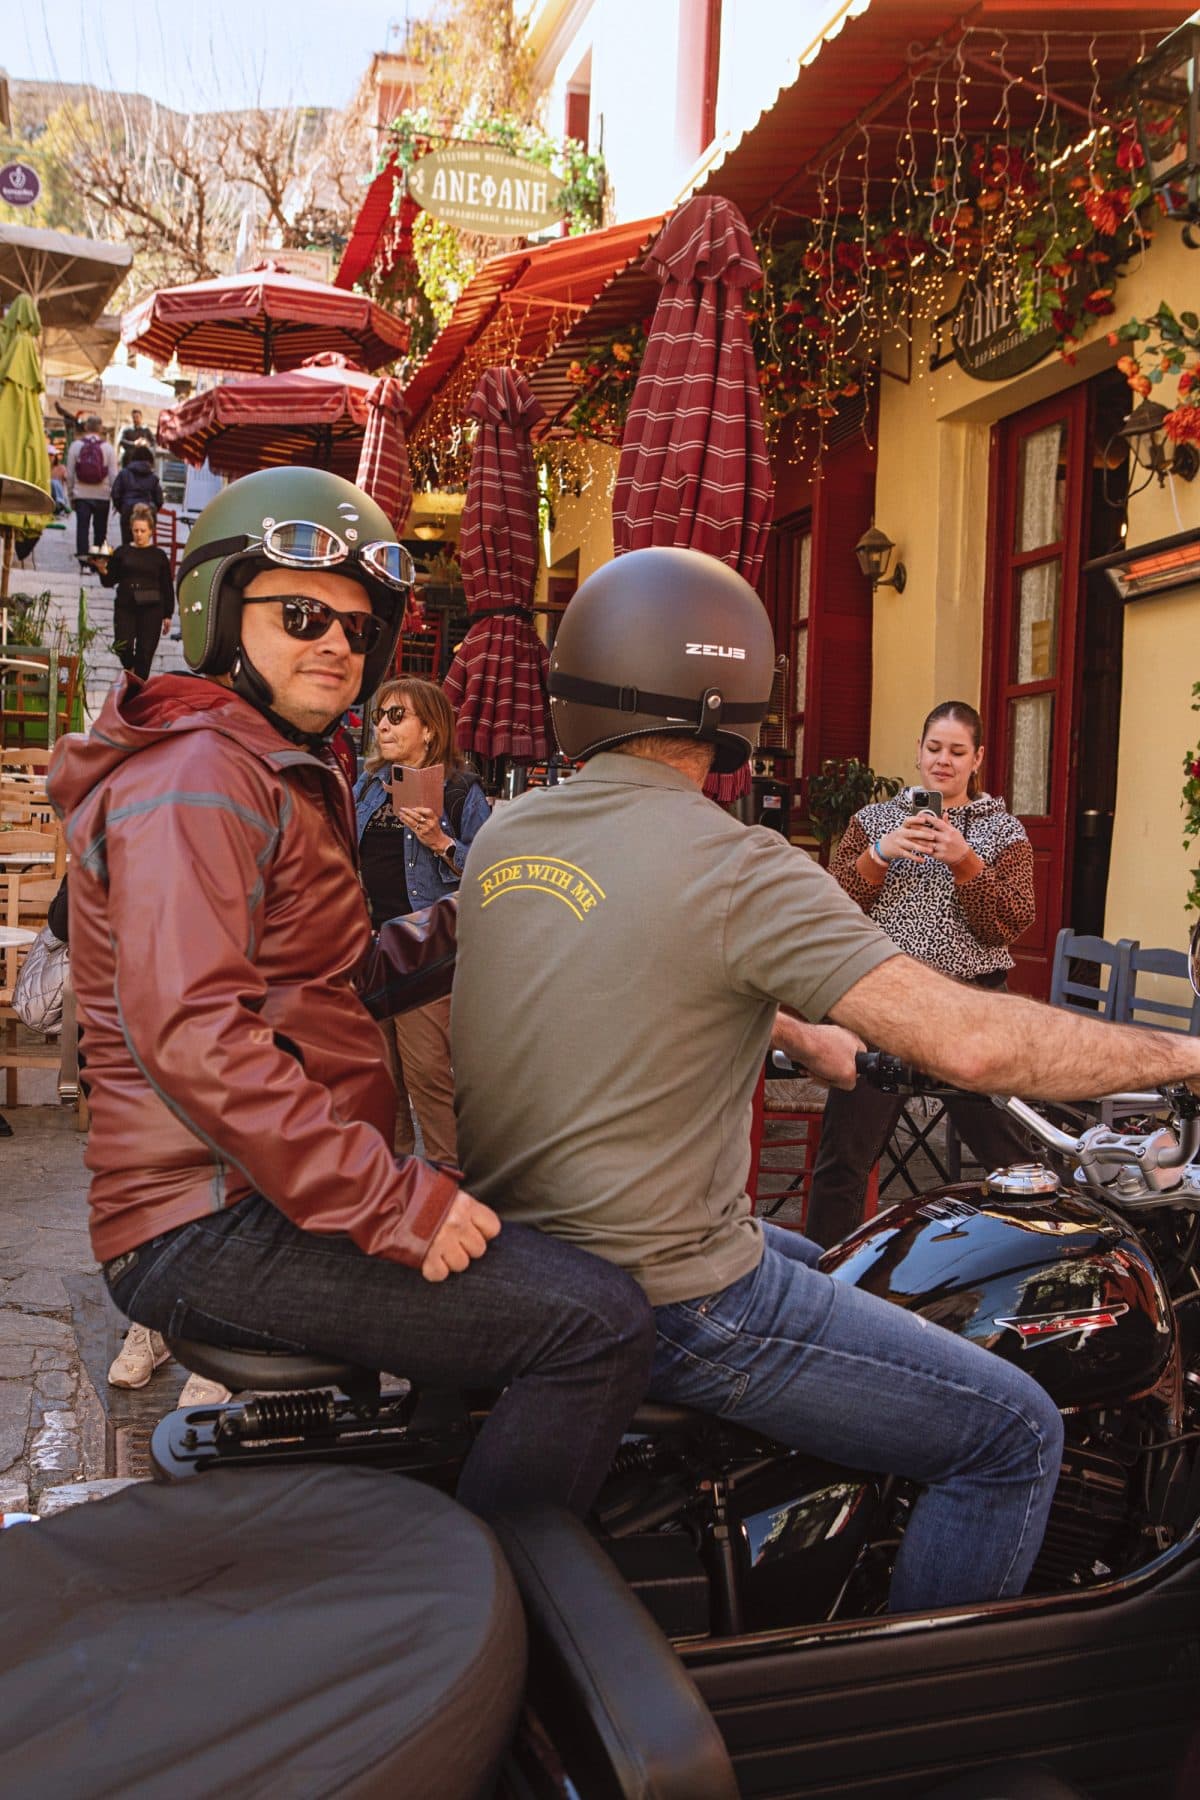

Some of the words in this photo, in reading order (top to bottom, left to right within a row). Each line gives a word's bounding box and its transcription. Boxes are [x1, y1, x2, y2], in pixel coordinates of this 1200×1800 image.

[431, 168, 548, 214] ΑΝΕΦΑΝΗ
[685, 643, 746, 660] ZEUS
[480, 864, 523, 897] RIDE
[526, 863, 575, 891] WITH
[569, 880, 598, 913] ME
